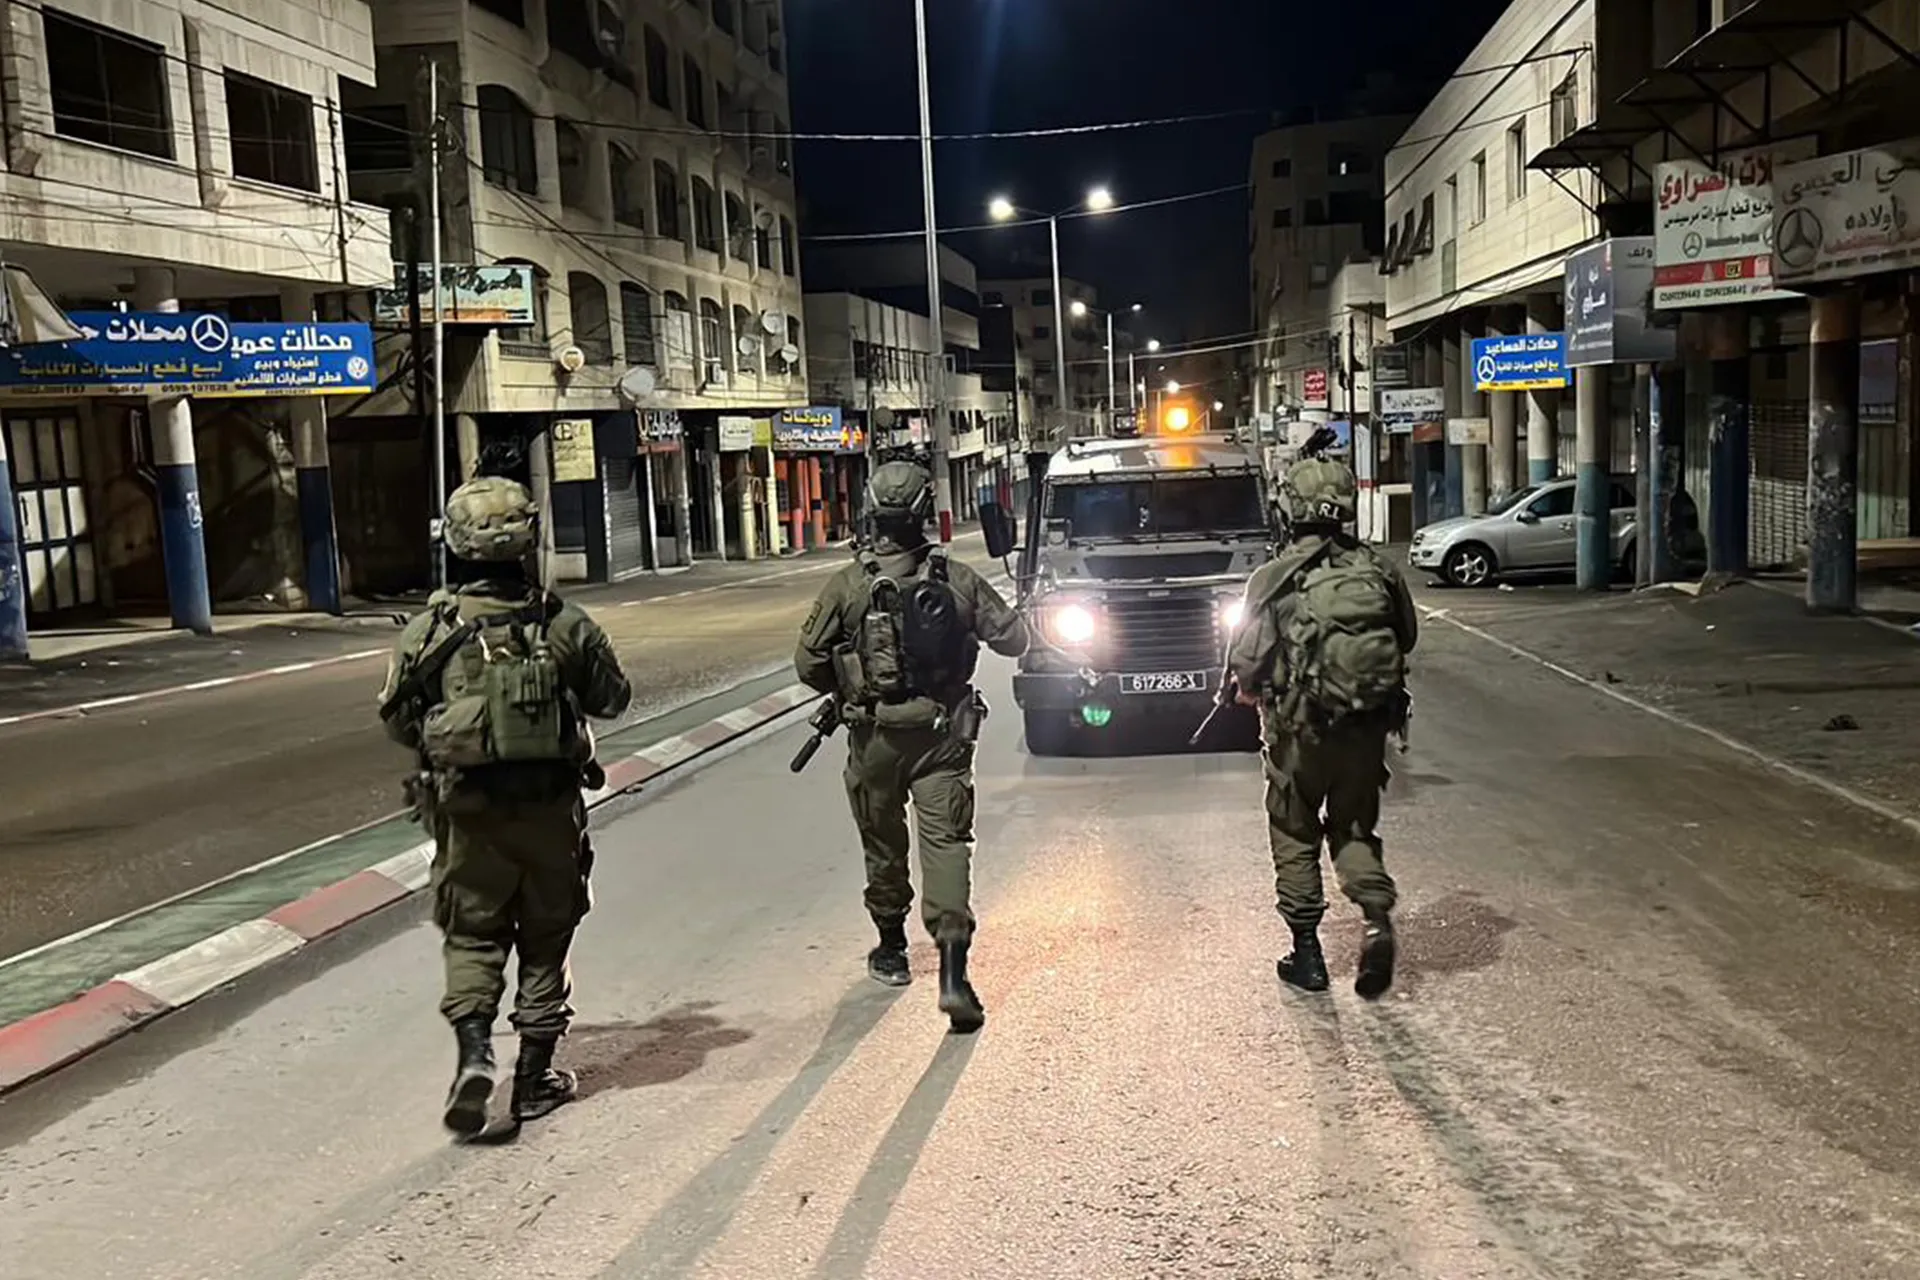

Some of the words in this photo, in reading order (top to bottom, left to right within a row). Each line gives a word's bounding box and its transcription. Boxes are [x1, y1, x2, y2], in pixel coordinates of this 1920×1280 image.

[105, 318, 188, 343] محلات
[281, 325, 353, 351] محلات
[81, 359, 149, 379] السيارات
[153, 356, 188, 379] قطع
[318, 371, 343, 385] قطع
